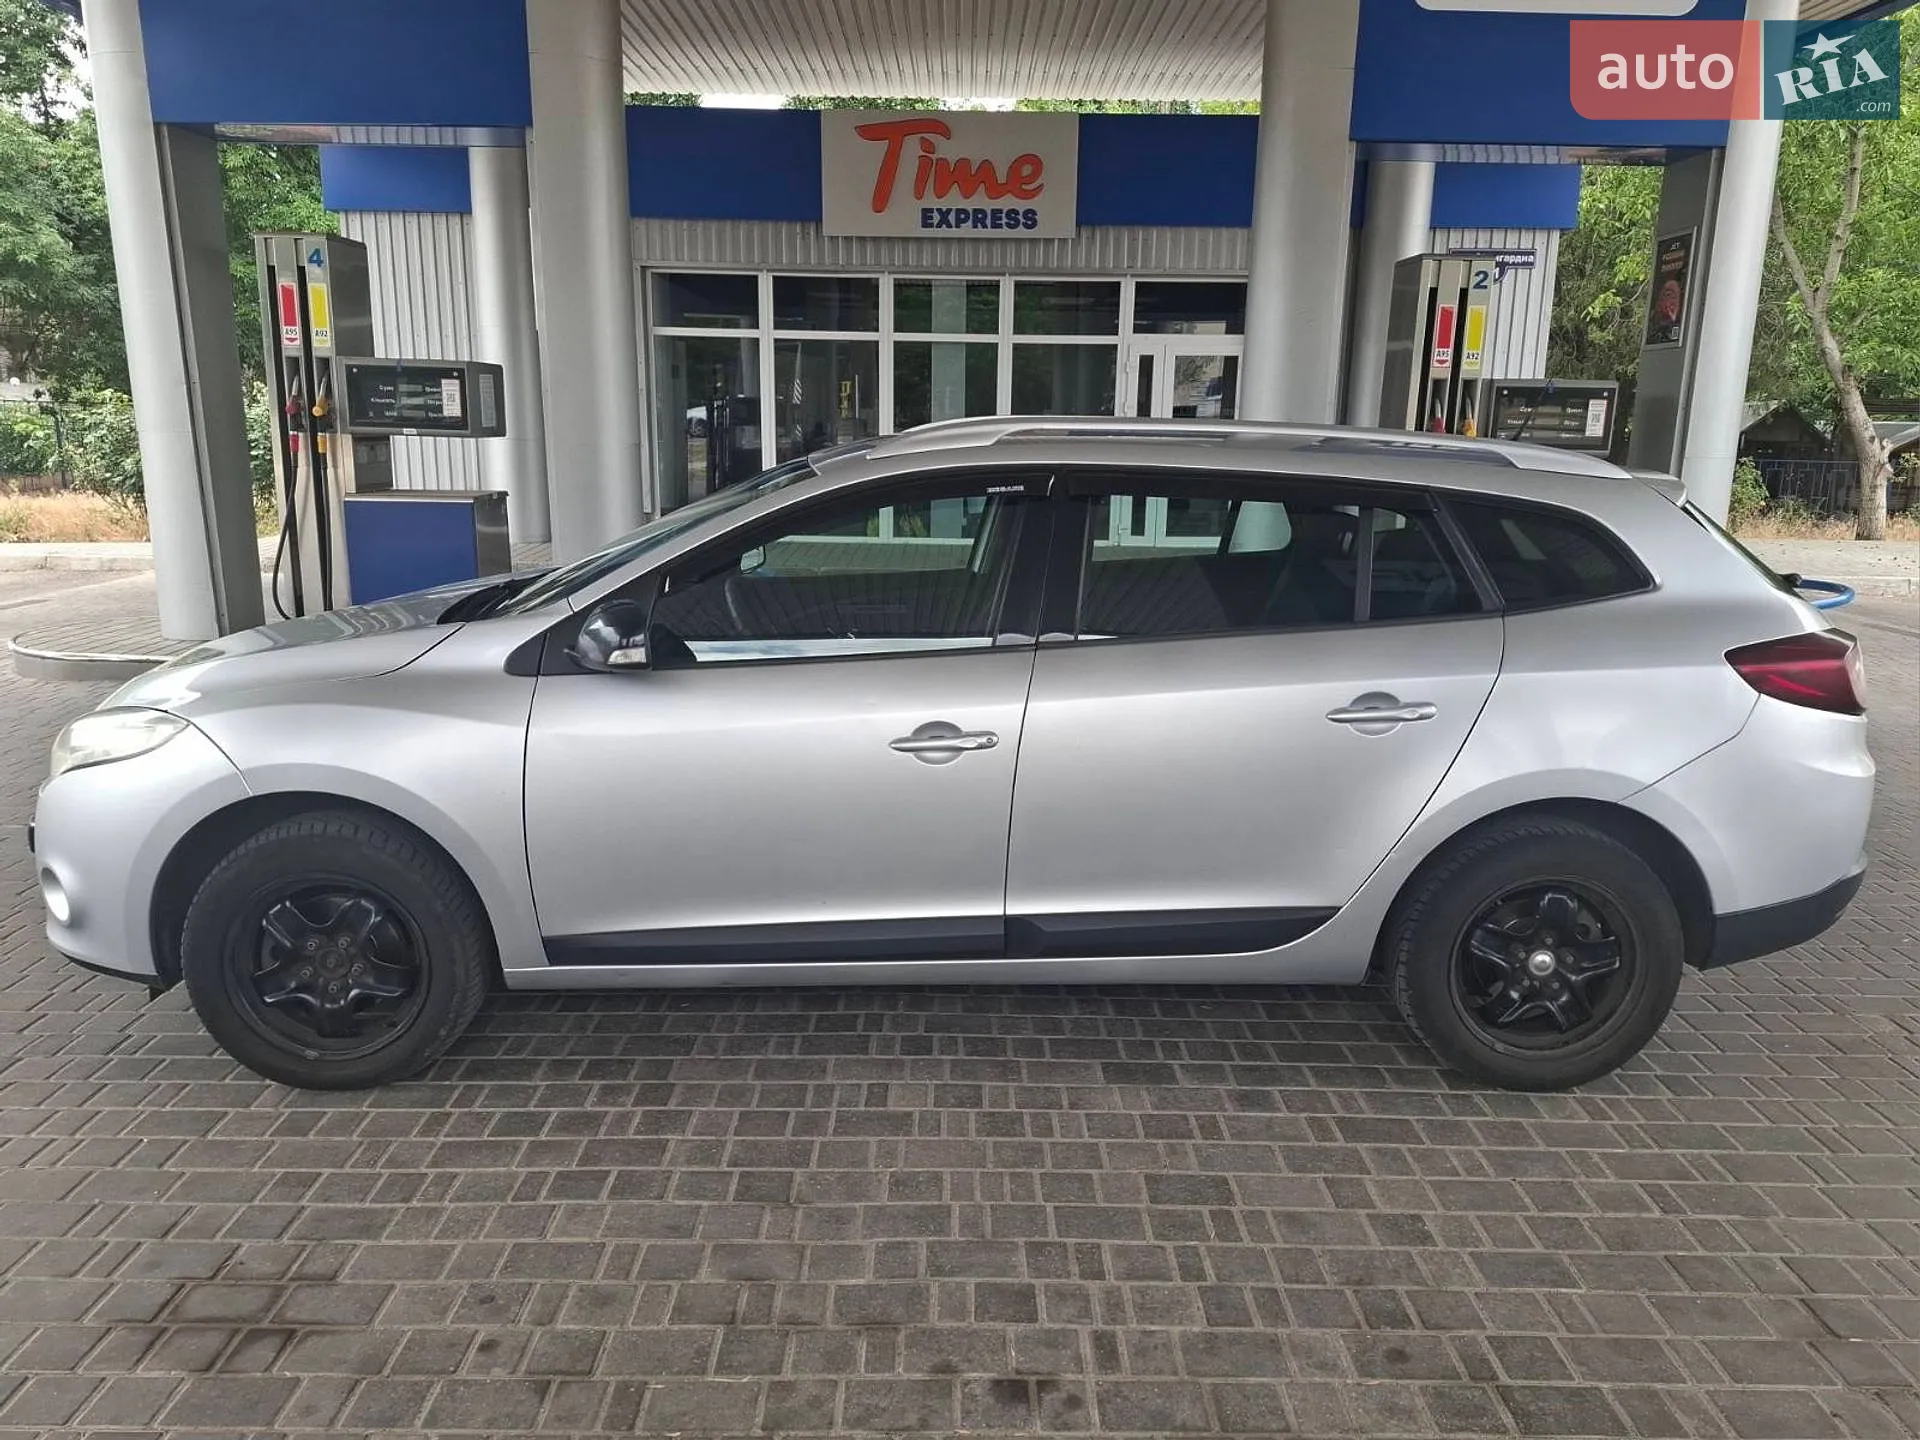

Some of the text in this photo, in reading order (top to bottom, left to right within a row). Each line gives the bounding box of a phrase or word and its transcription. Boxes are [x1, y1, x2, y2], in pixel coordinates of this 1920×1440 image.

[854, 118, 1045, 214] Time
[920, 207, 1039, 230] EXPRESS
[307, 247, 324, 268] 4
[1472, 270, 1489, 290] 2
